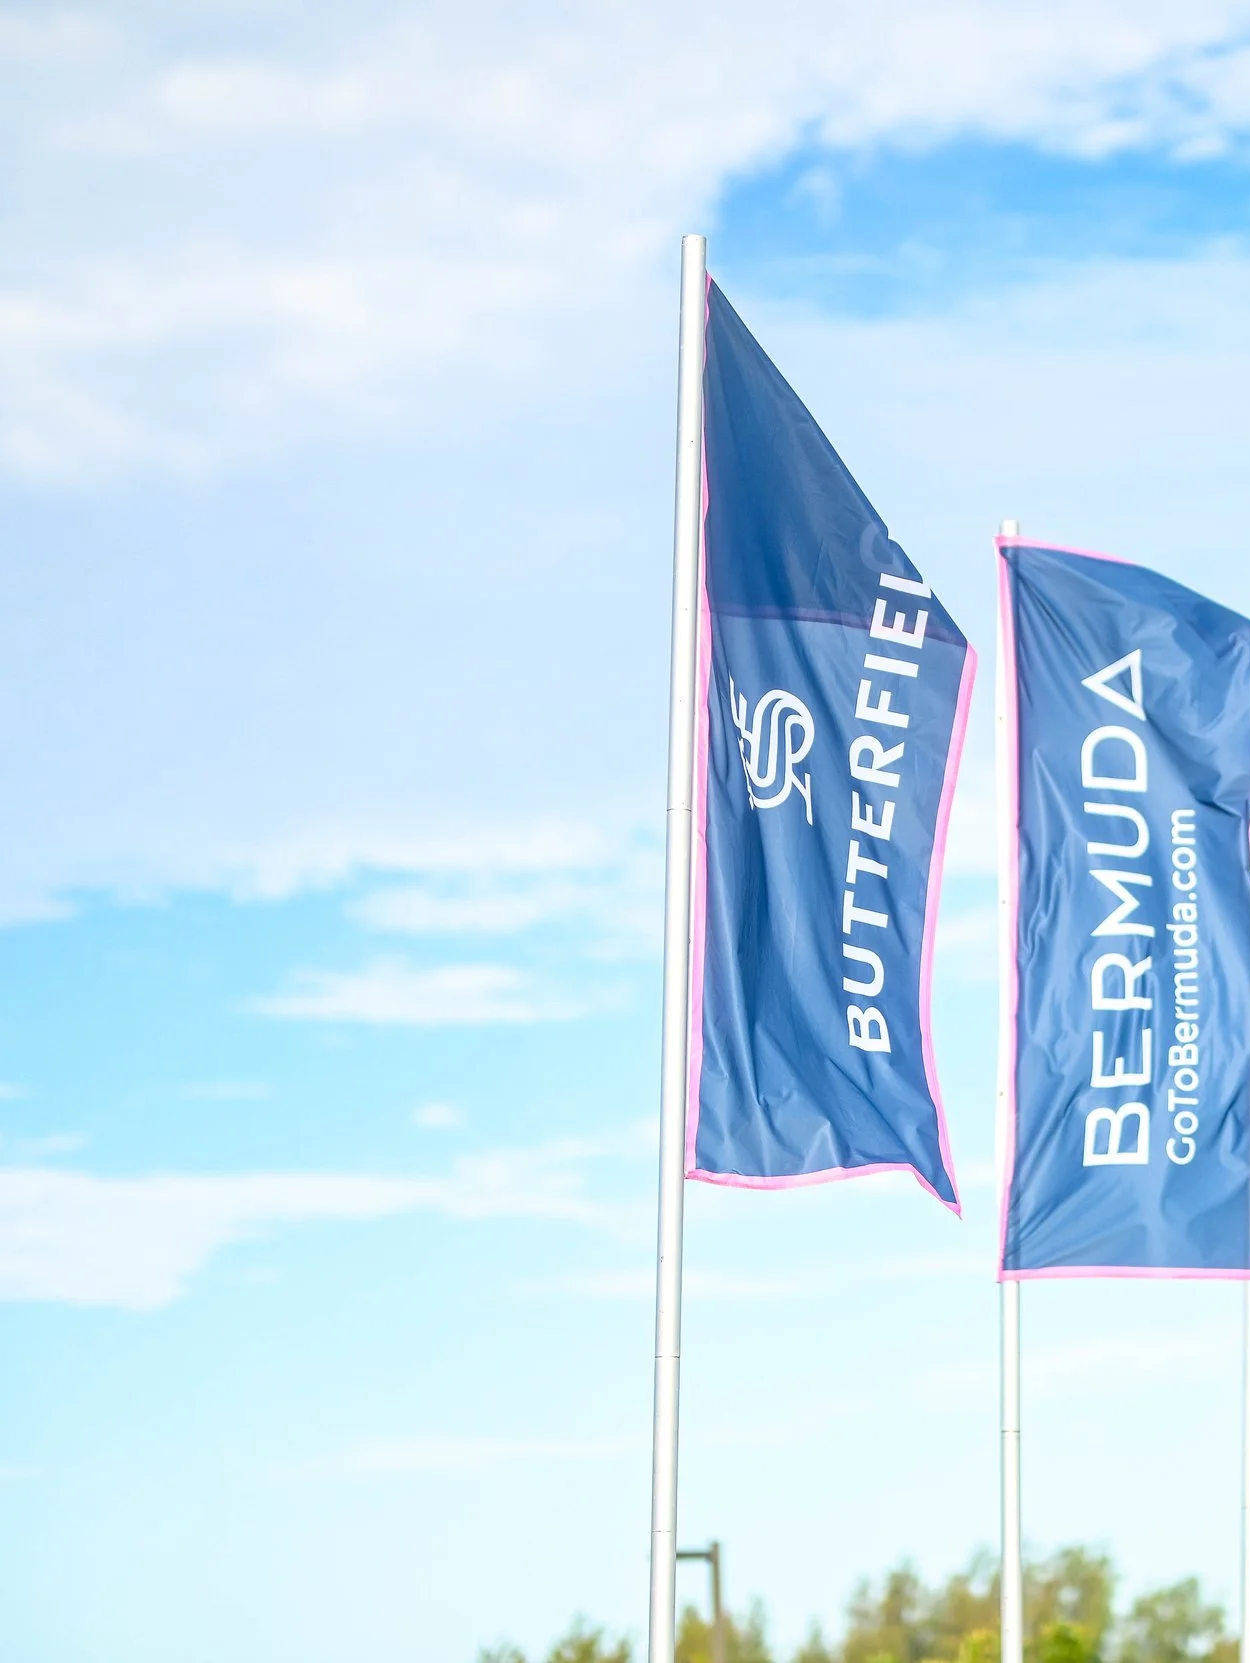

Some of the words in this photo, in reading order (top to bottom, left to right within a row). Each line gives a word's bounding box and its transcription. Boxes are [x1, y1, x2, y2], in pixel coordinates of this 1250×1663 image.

[843, 573, 932, 1053] BUTTERFIEL
[1081, 648, 1155, 1166] BERMUDA
[1166, 809, 1199, 1165] GoToBermuda.com
